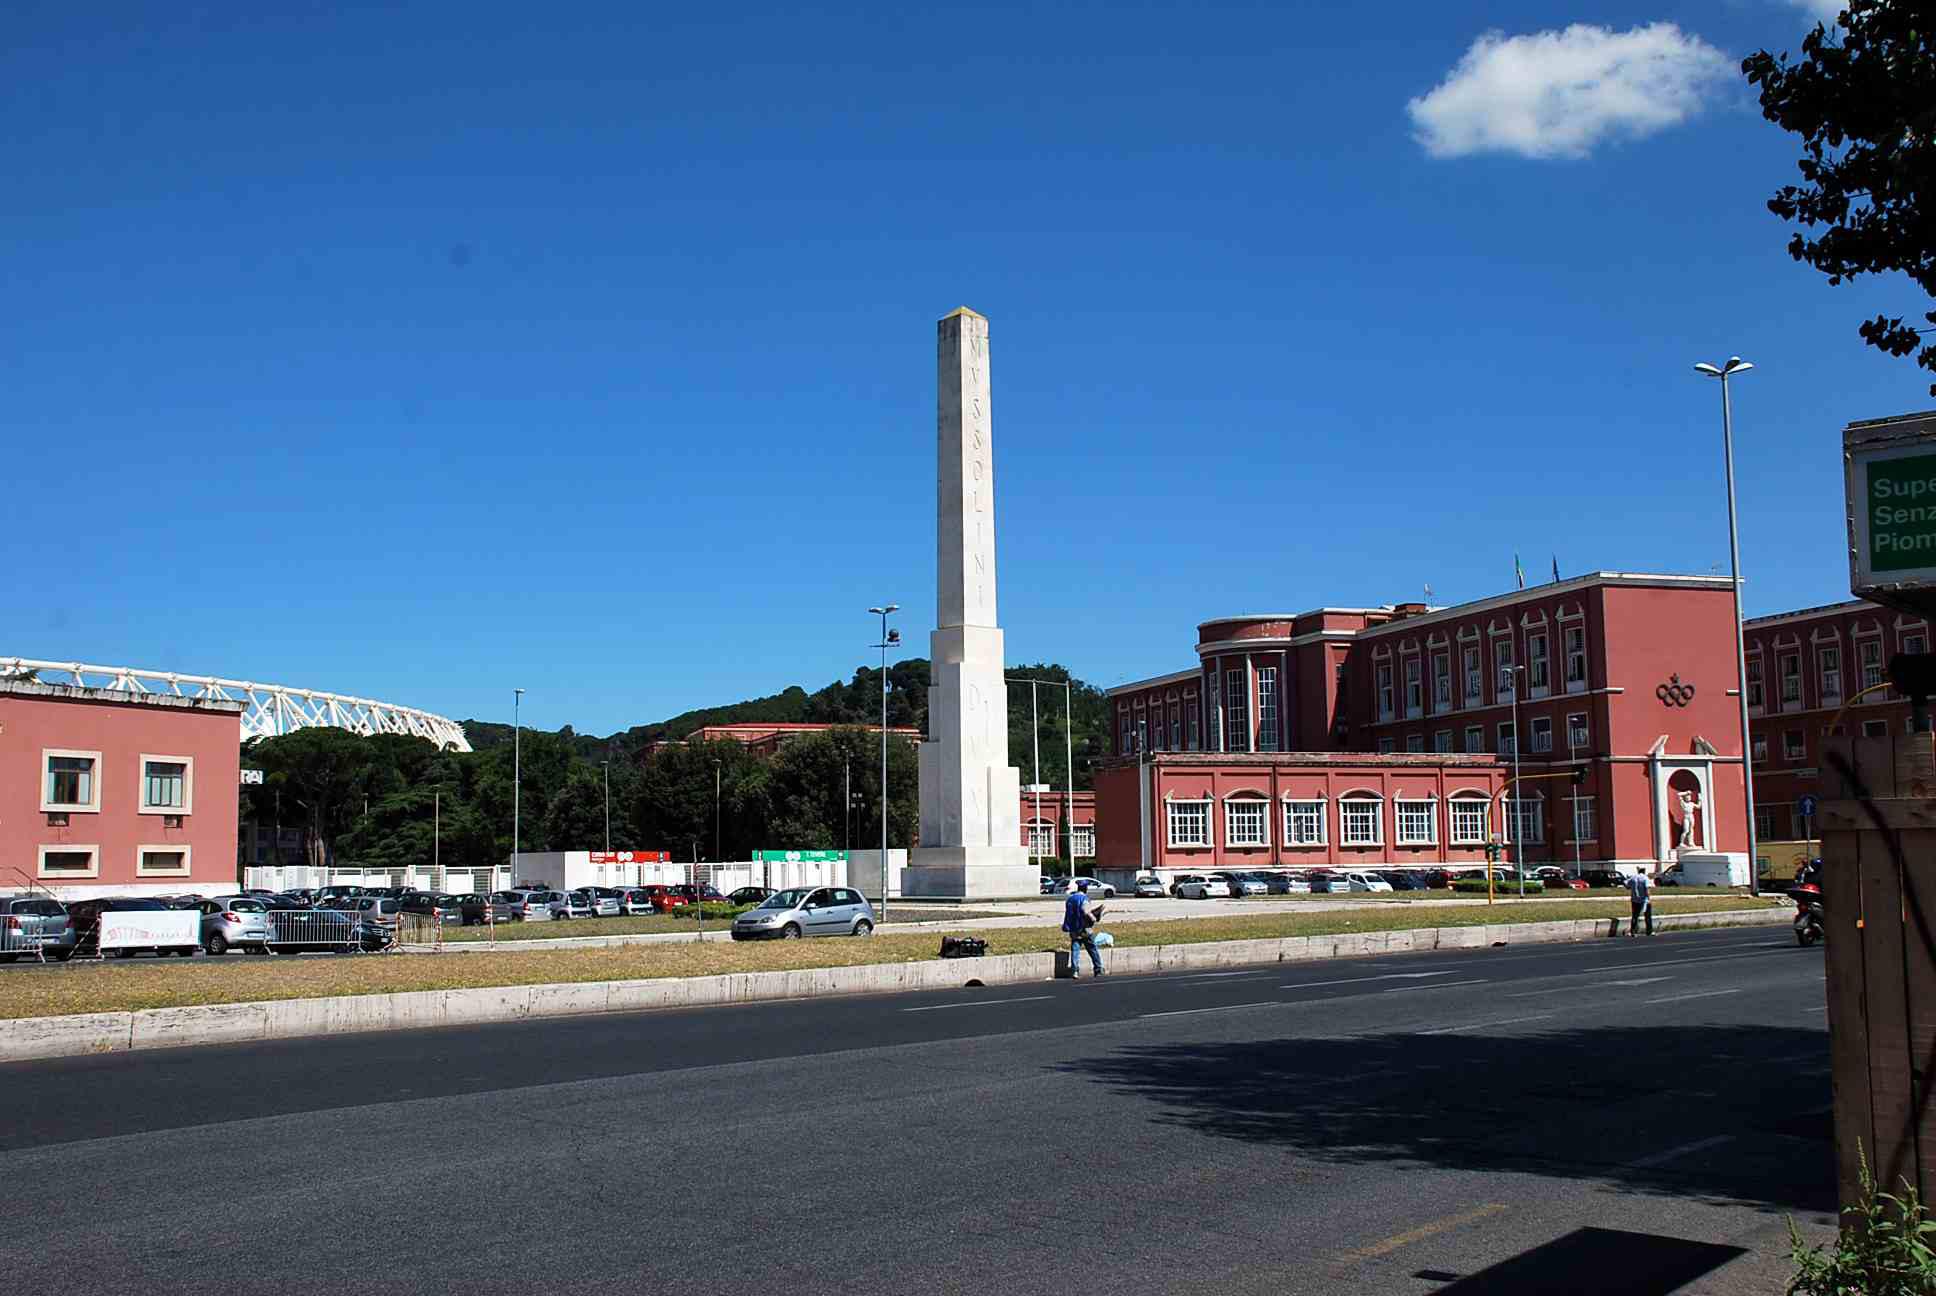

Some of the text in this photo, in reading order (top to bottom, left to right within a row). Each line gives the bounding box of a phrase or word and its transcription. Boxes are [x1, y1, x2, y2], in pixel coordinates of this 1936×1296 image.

[1873, 478, 1936, 499] Supe
[1875, 505, 1936, 525] Senz
[1875, 532, 1936, 552] Piom
